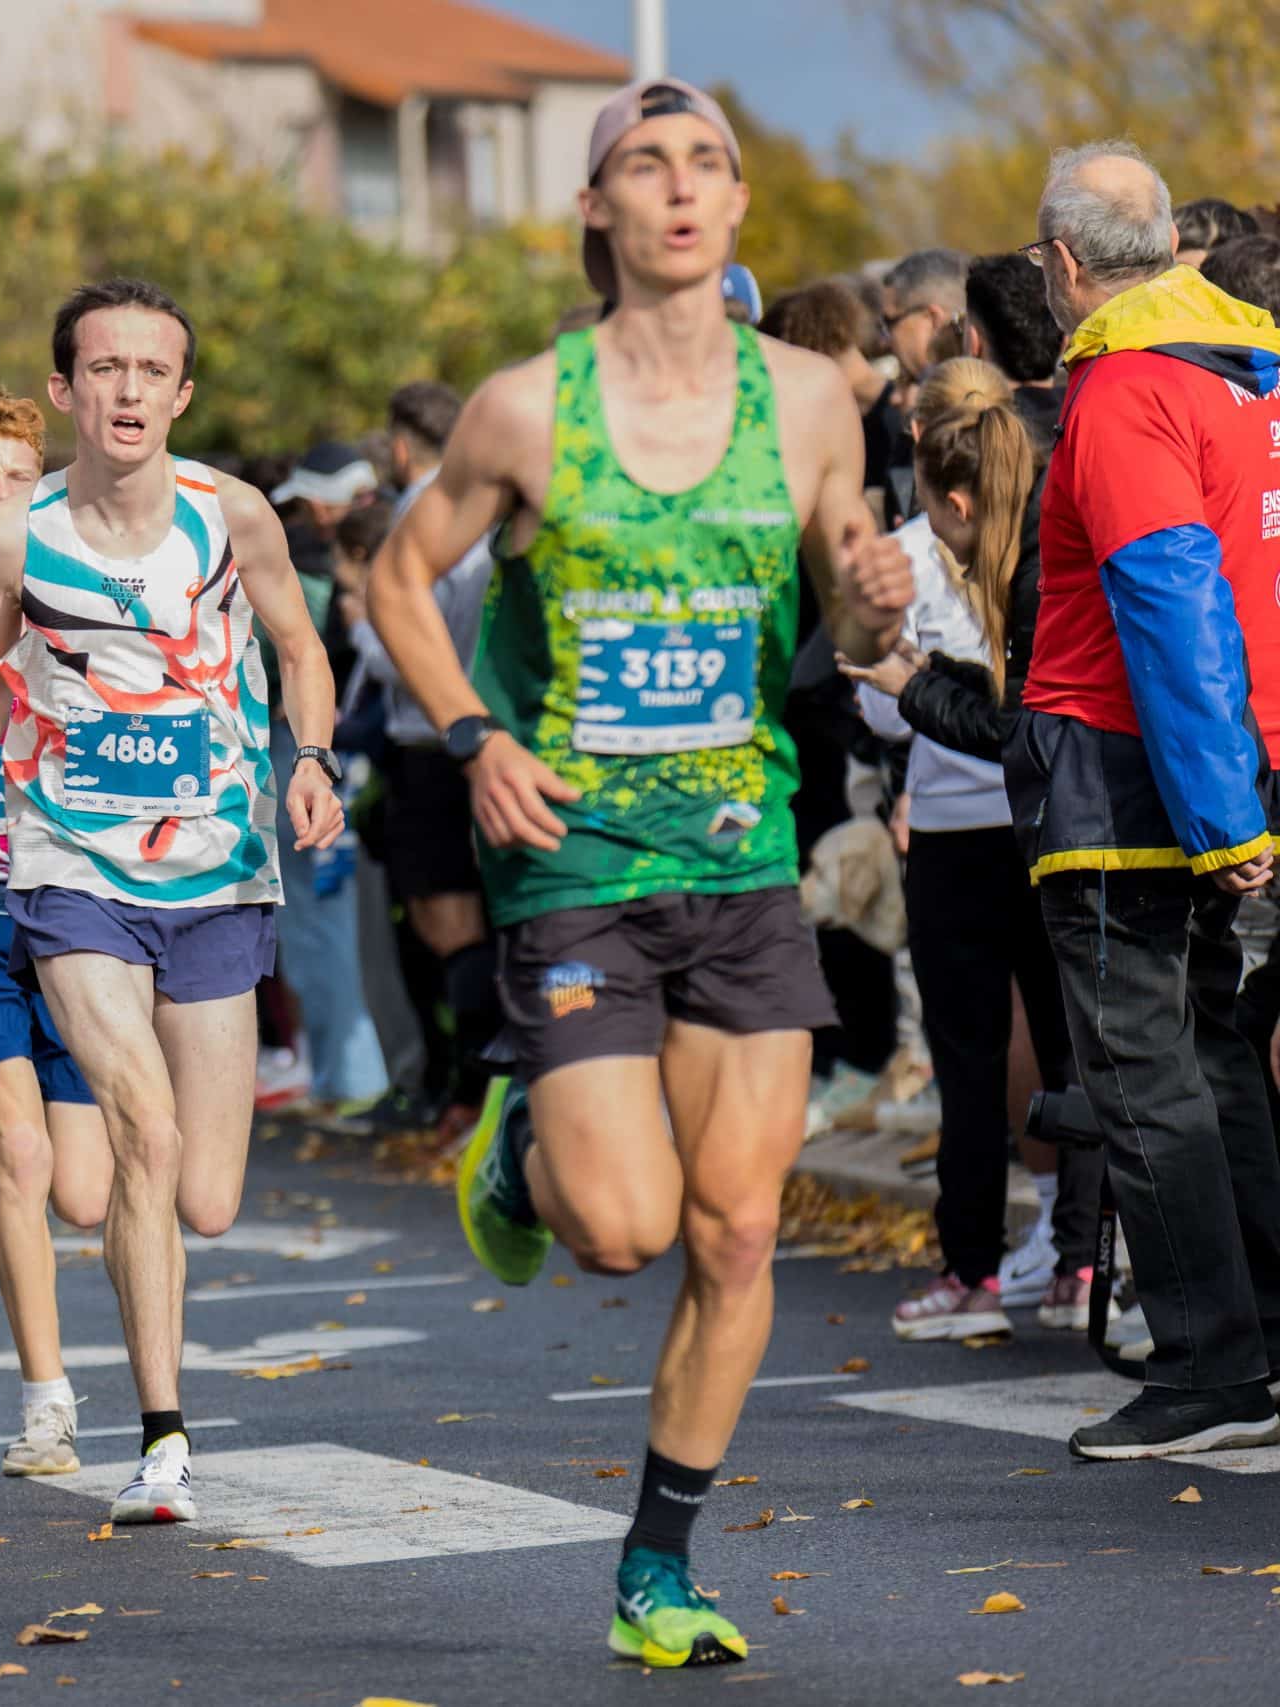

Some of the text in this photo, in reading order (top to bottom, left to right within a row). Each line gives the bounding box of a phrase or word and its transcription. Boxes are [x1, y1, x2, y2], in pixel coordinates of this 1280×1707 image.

[101, 583, 146, 593] VICTORY
[620, 648, 726, 688] 3139
[639, 689, 704, 706] THIBAUT
[97, 733, 179, 765] 4886
[1098, 1220, 1112, 1277] SONY
